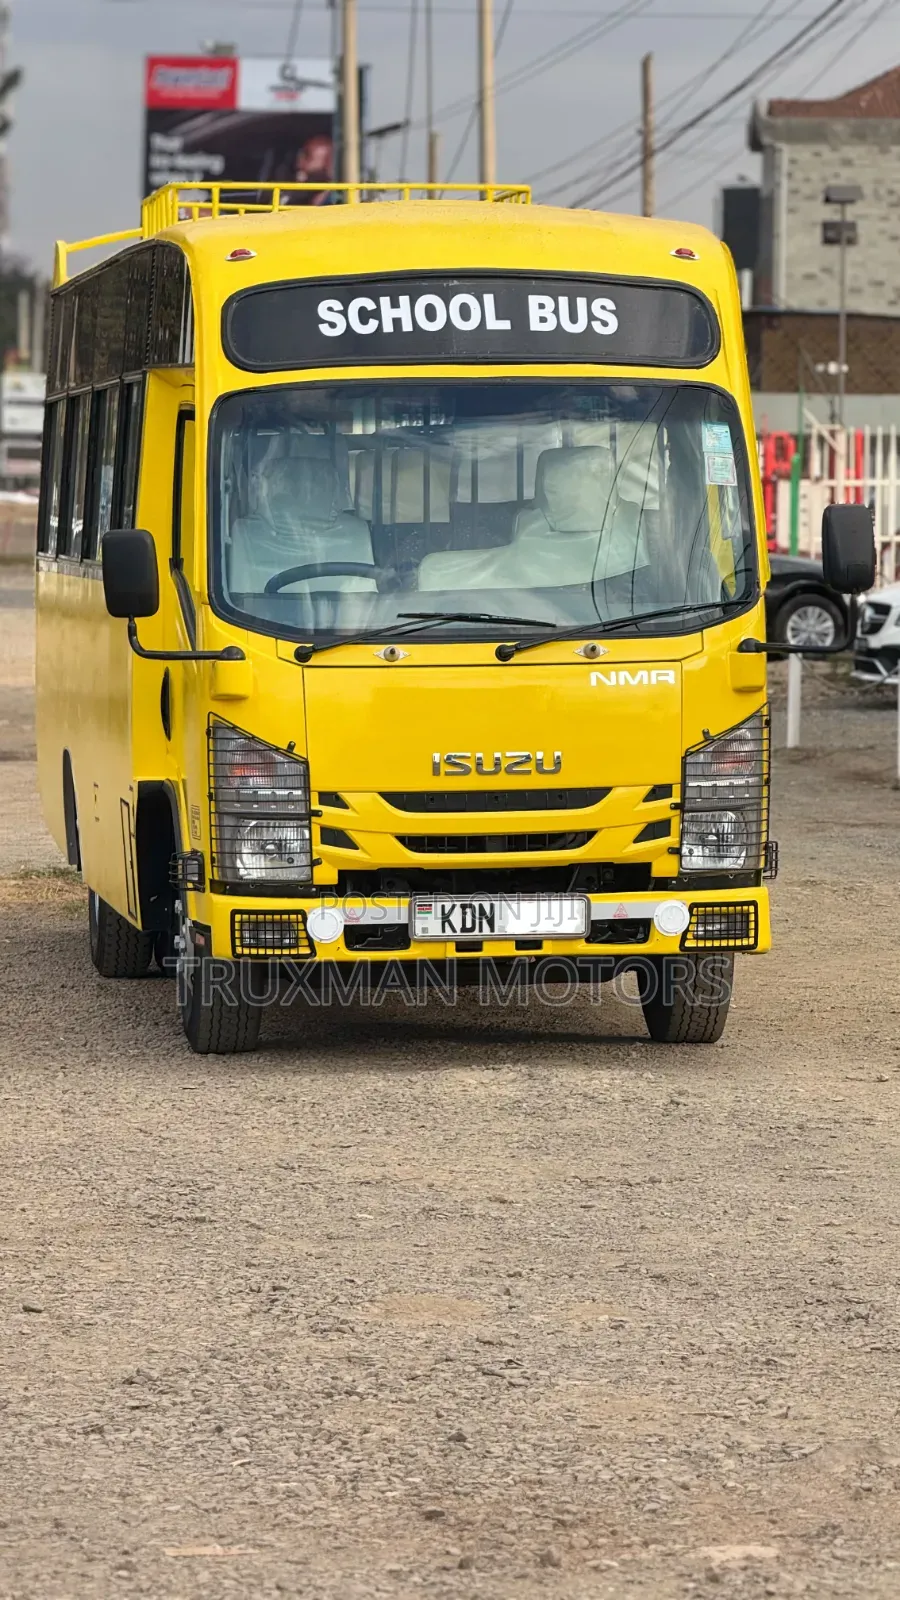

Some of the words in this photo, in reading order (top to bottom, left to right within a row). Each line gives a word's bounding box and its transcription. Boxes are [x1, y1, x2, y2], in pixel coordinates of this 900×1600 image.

[318, 293, 511, 336] SCHOOL
[528, 294, 618, 335] BUS
[589, 669, 676, 687] NMR
[432, 751, 562, 776] ISUZU
[441, 903, 496, 934] KDN
